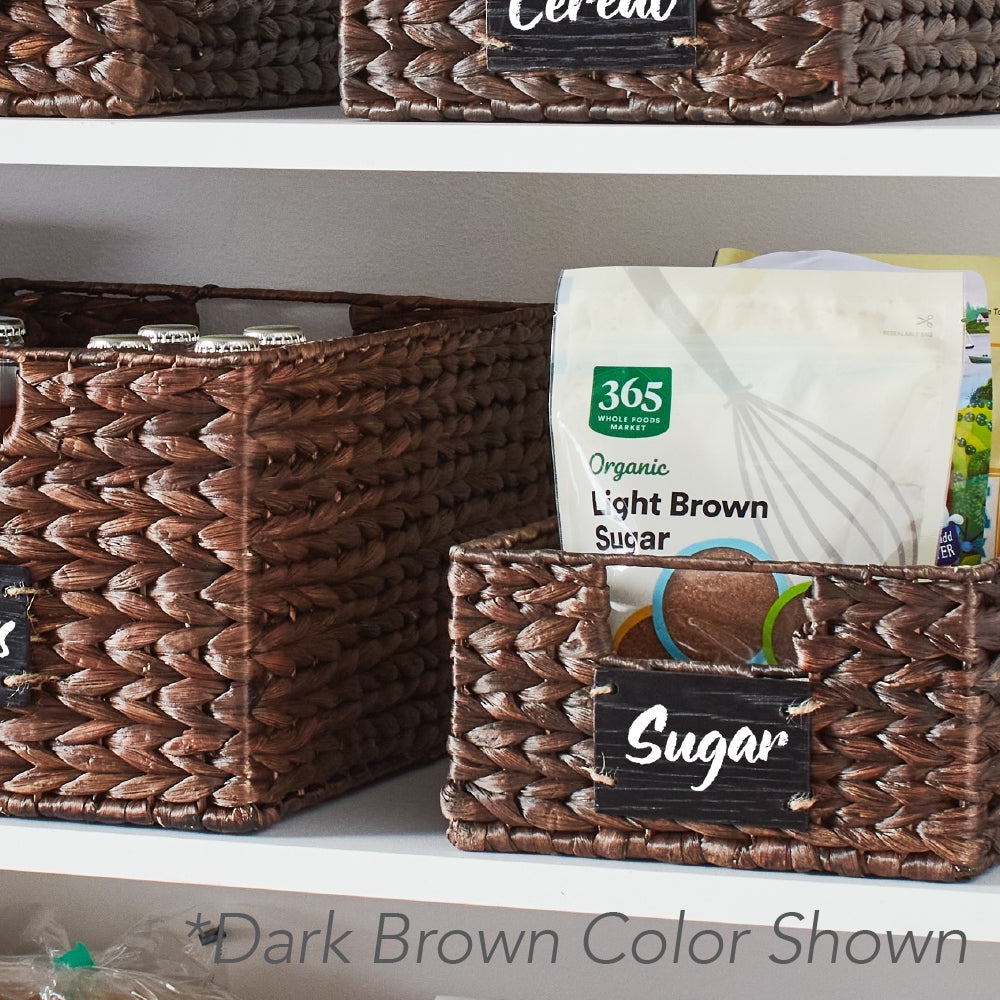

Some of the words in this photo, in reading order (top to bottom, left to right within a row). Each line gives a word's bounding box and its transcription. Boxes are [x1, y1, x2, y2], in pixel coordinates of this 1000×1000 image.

[598, 376, 663, 412] 365
[597, 415, 628, 423] WHOLE
[631, 416, 661, 424] FOODS
[589, 452, 670, 482] Organic
[591, 489, 662, 521] Light
[669, 491, 769, 519] Brown
[595, 524, 671, 554] Sugar
[625, 704, 789, 792] Sugar
